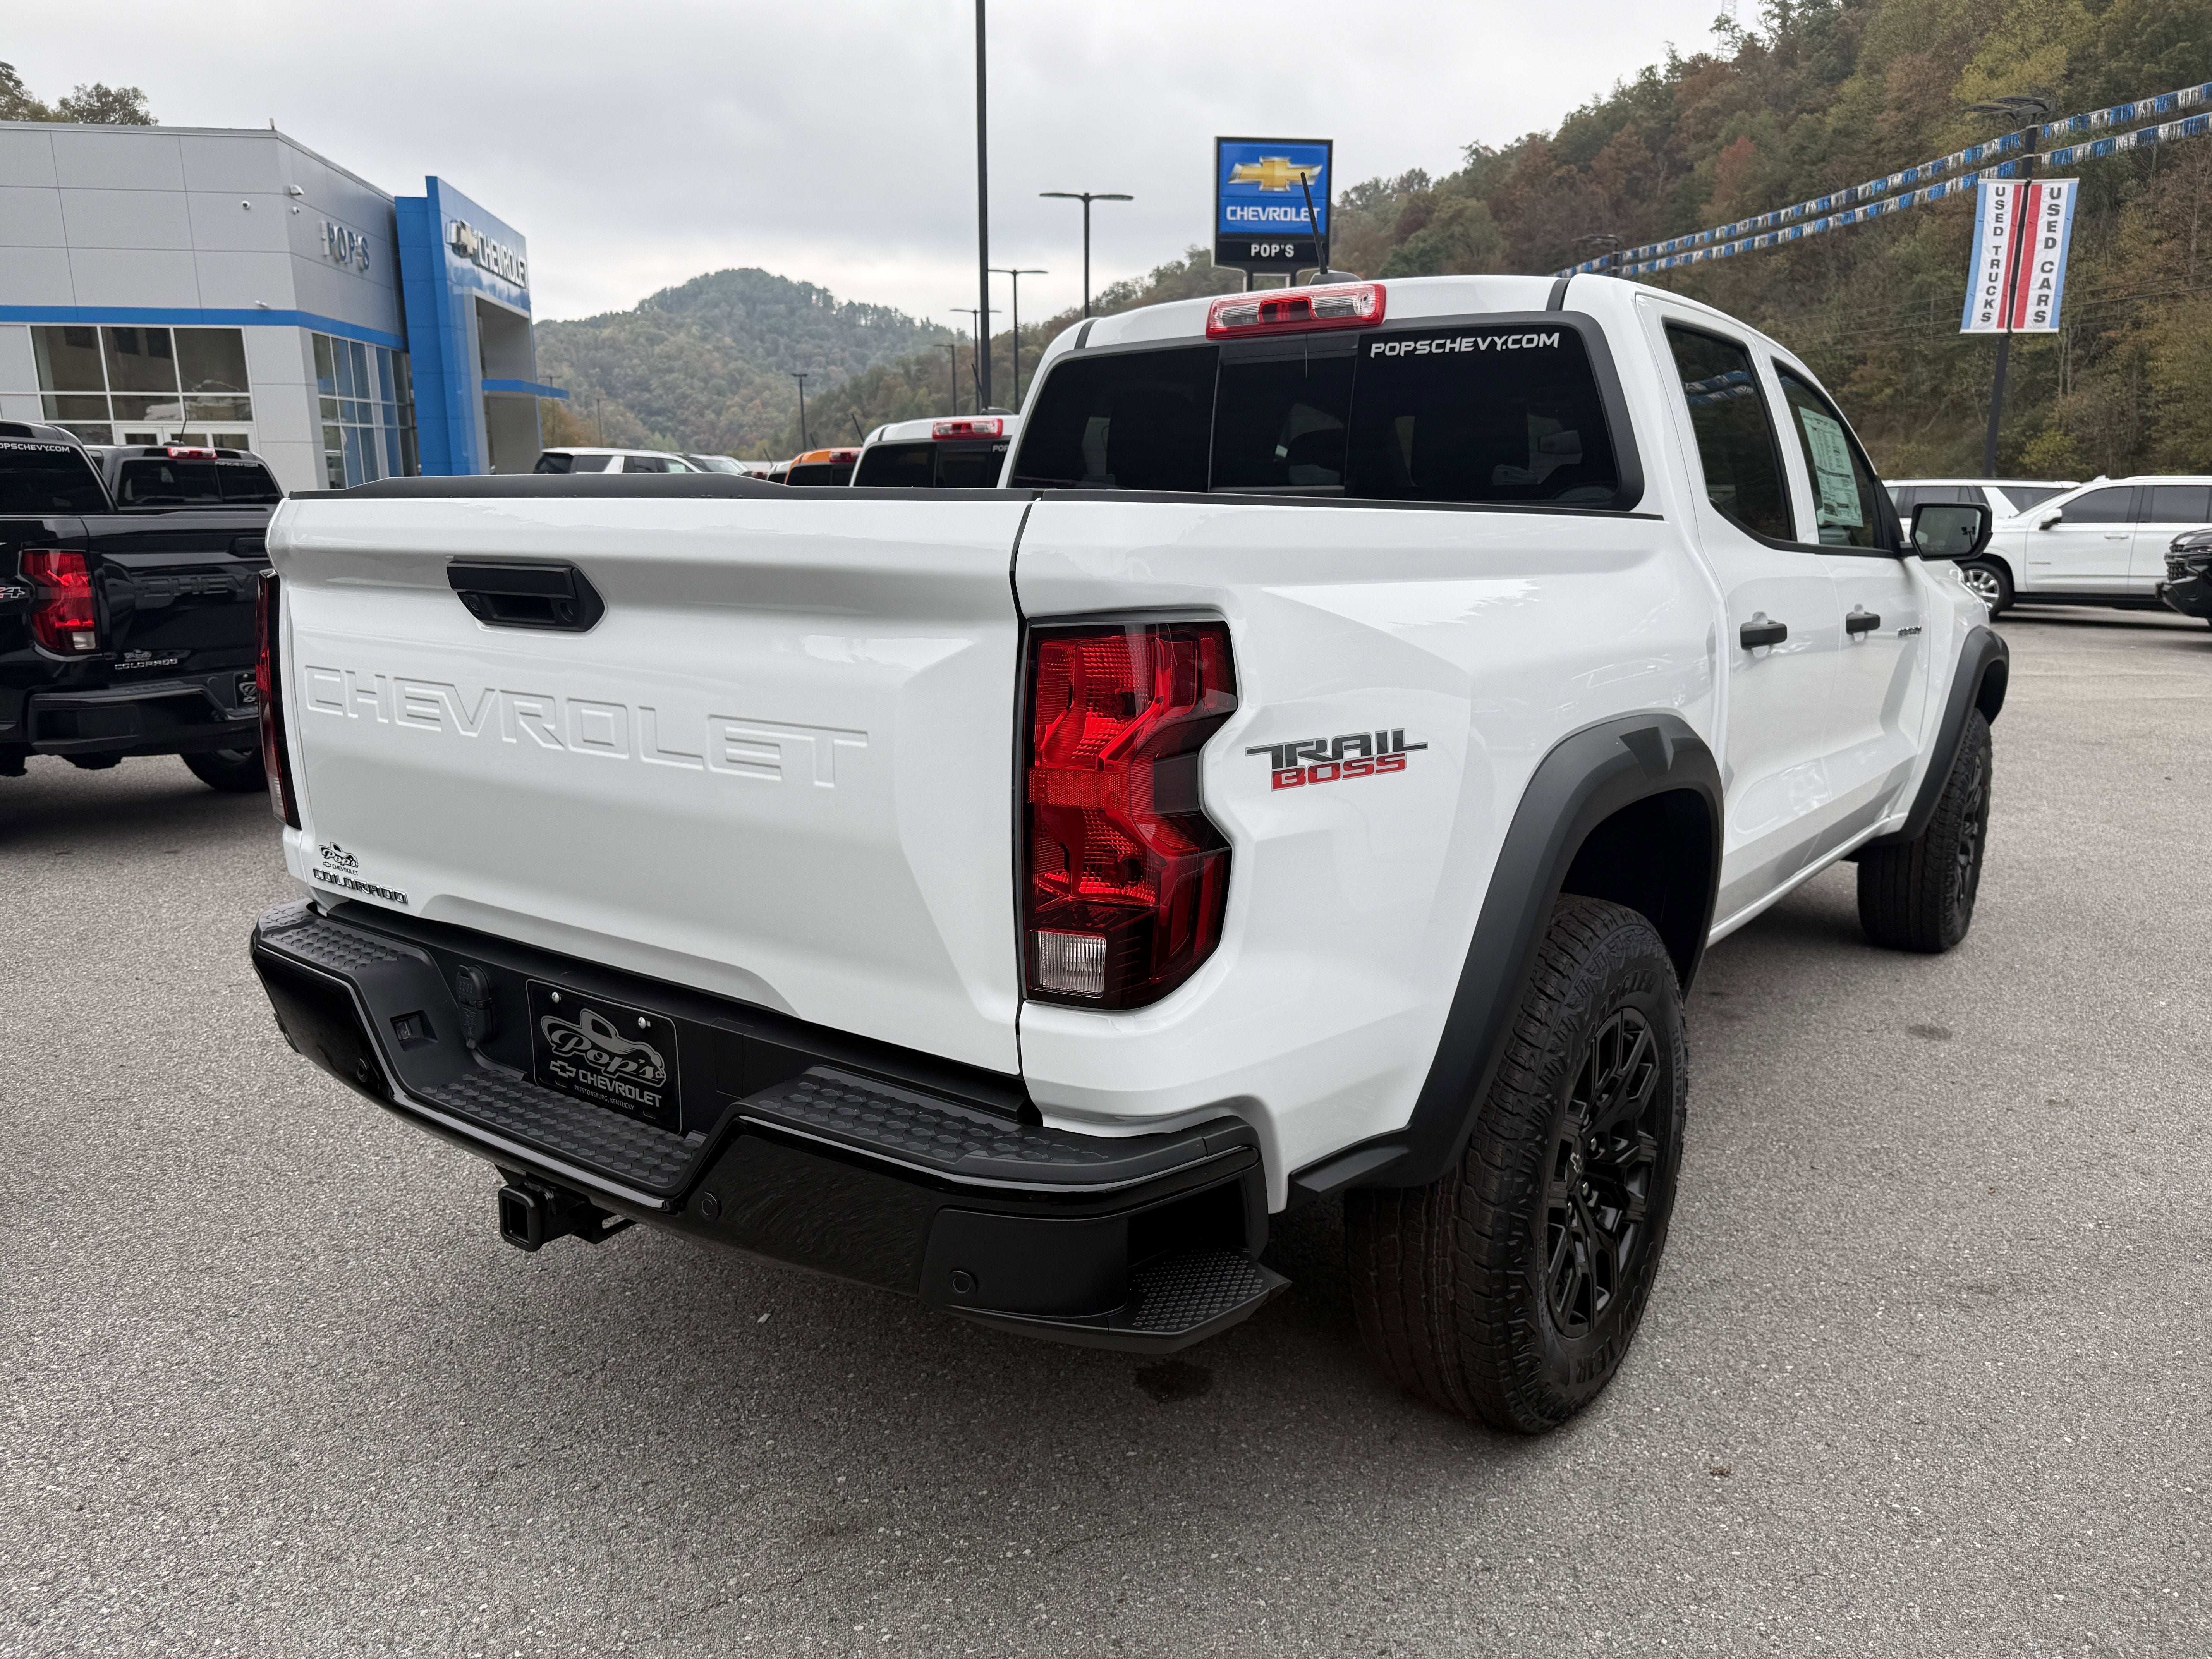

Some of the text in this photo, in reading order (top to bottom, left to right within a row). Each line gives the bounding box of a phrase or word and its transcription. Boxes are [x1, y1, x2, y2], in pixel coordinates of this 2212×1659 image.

[1226, 206, 1320, 221] CHEVROLET
[324, 220, 370, 270] POP'S
[477, 230, 528, 288] CHEVROLET
[1251, 244, 1294, 258] POP'S
[1980, 187, 2006, 322] USED TRUCKS
[2033, 187, 2061, 323] USED CARS
[1370, 333, 1560, 358] POPSCHEVY.COM
[305, 664, 869, 788] CHEVROLET
[1245, 728, 1428, 769] TRAIL
[1271, 752, 1407, 792] BOSS
[313, 868, 408, 904] COLORADO
[332, 864, 358, 876] CHEVROLET
[551, 1030, 657, 1080] Pop's
[574, 1085, 634, 1110] PRESTONSBURG, KENTUCKY
[579, 1069, 662, 1107] CHEVROLET
